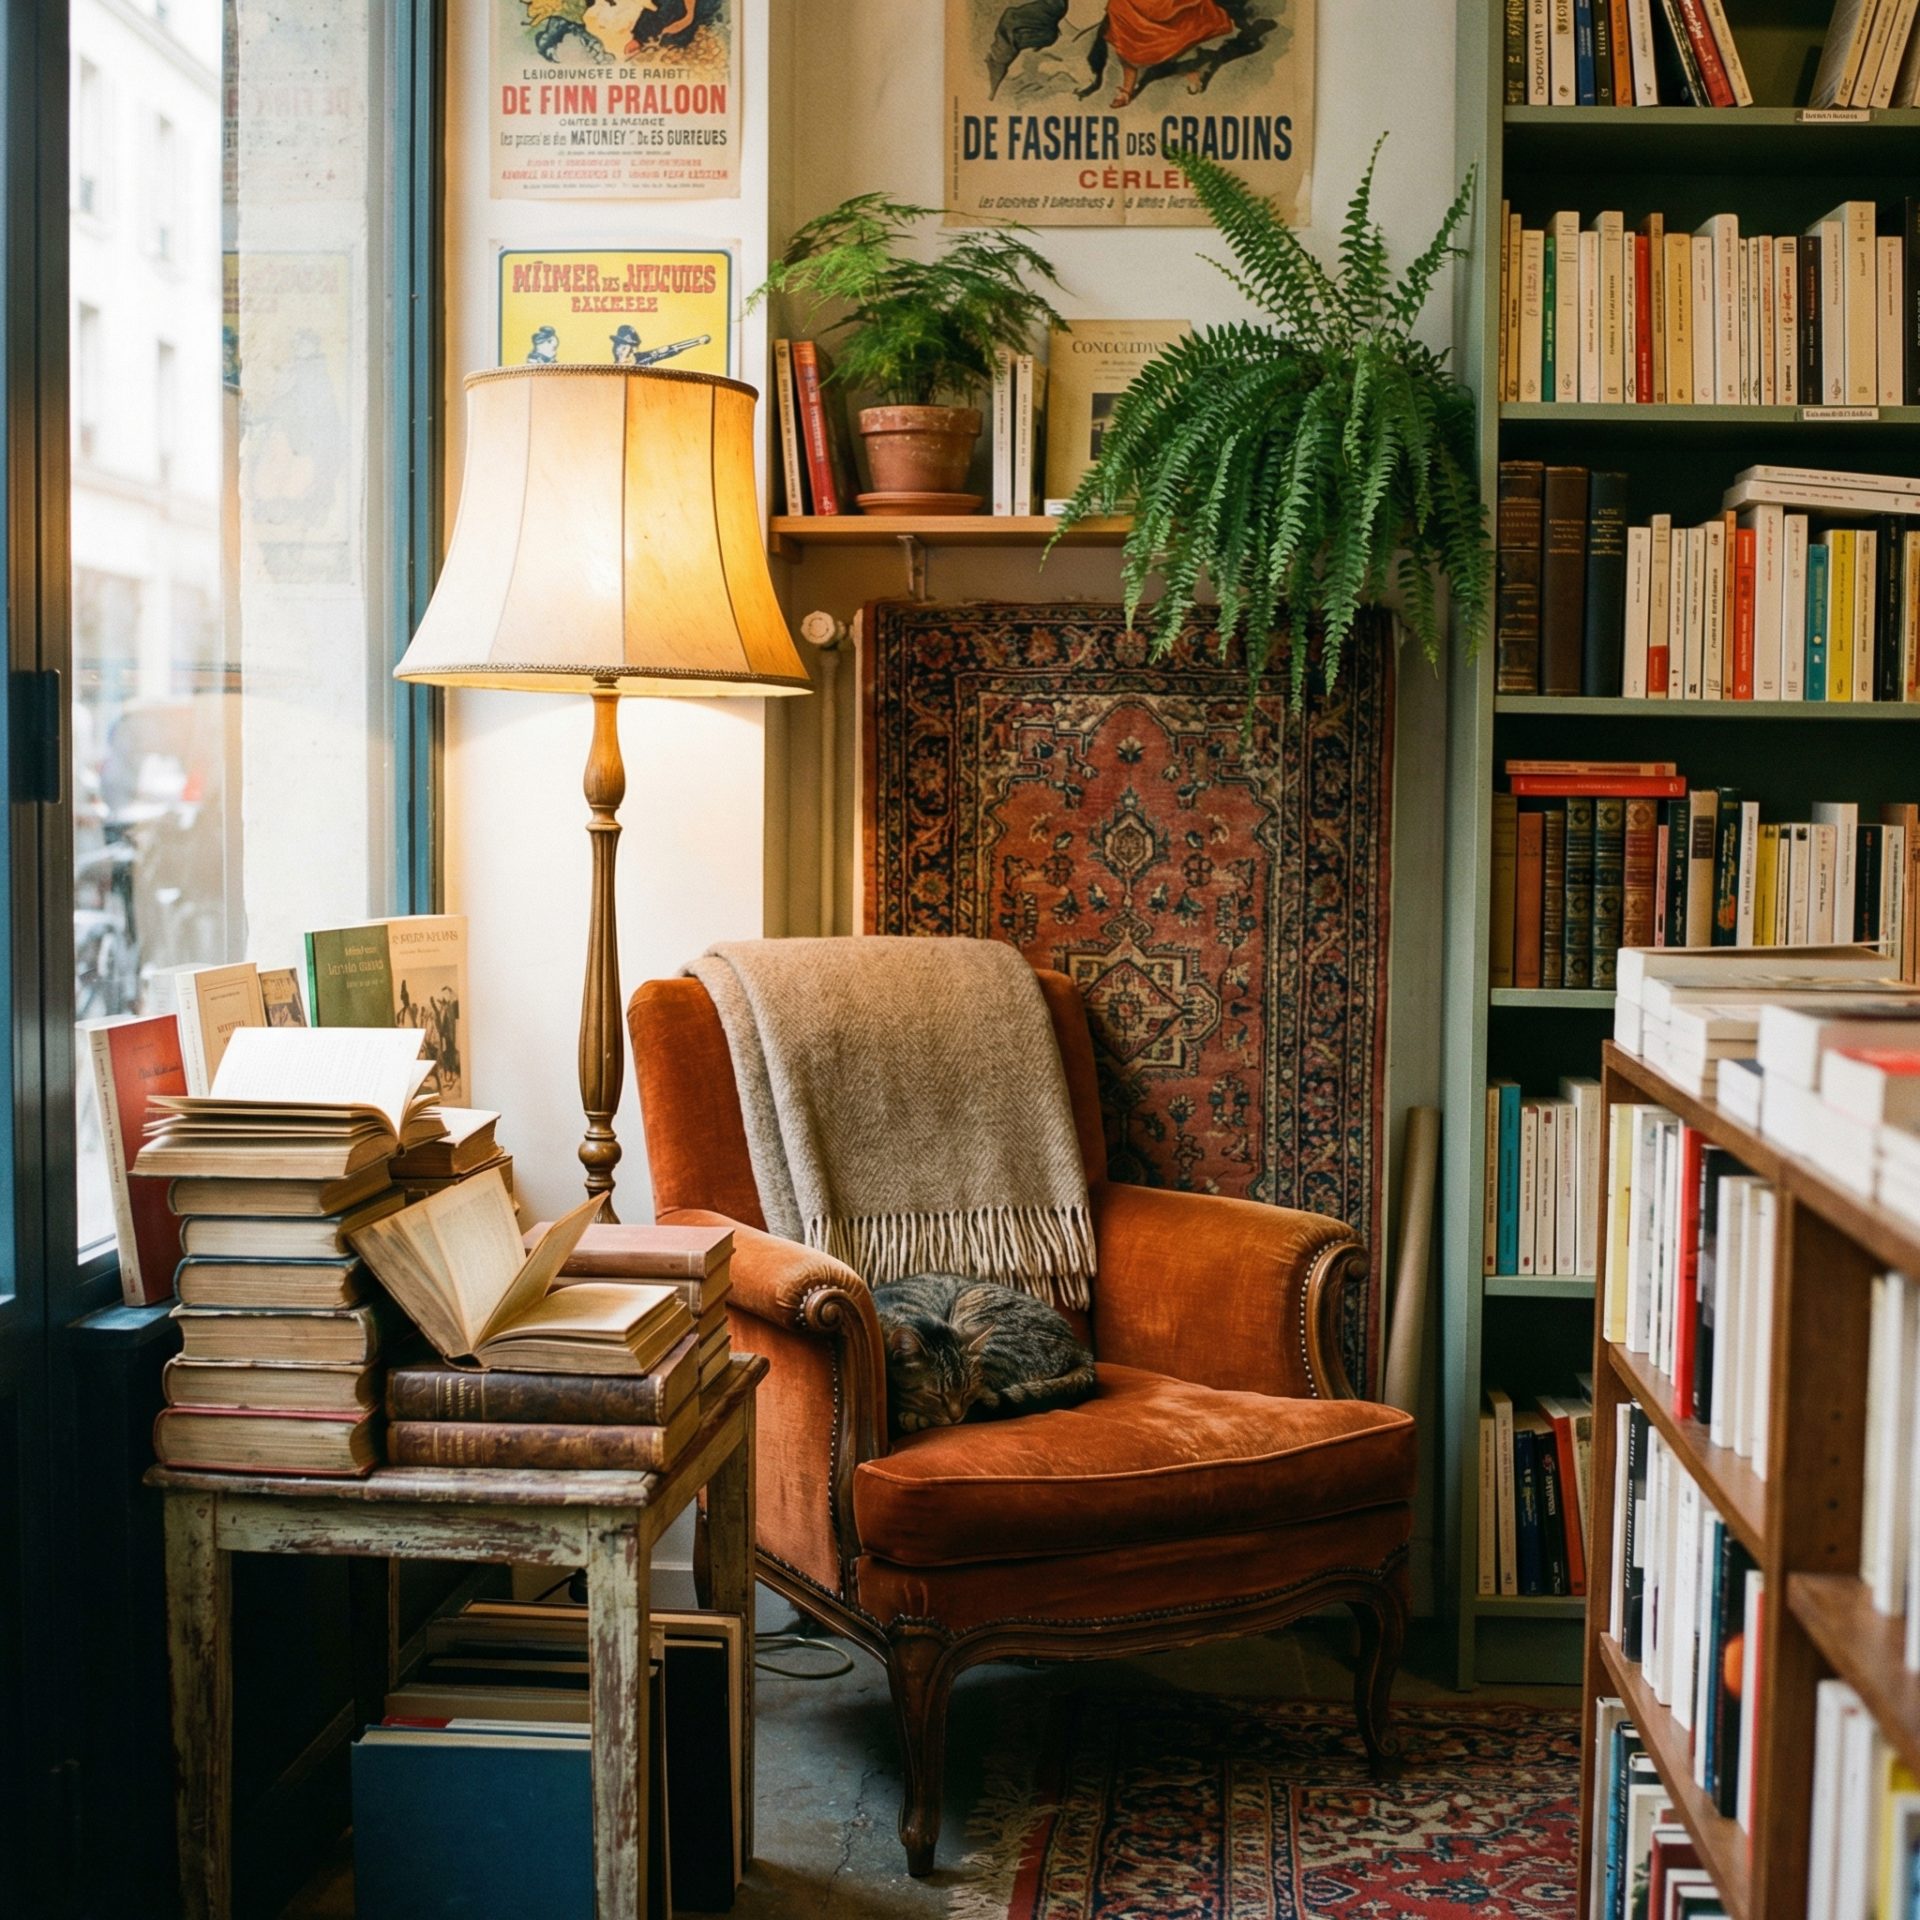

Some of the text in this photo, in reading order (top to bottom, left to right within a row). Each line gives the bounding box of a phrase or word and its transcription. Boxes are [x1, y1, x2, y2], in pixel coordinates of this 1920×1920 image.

[619, 69, 637, 80] DE
[502, 84, 727, 115] DE FINN PRALOON
[963, 115, 999, 161] DE
[1008, 115, 1119, 161] FASHER
[1126, 132, 1156, 157] DES
[1161, 115, 1293, 162] GRADINS
